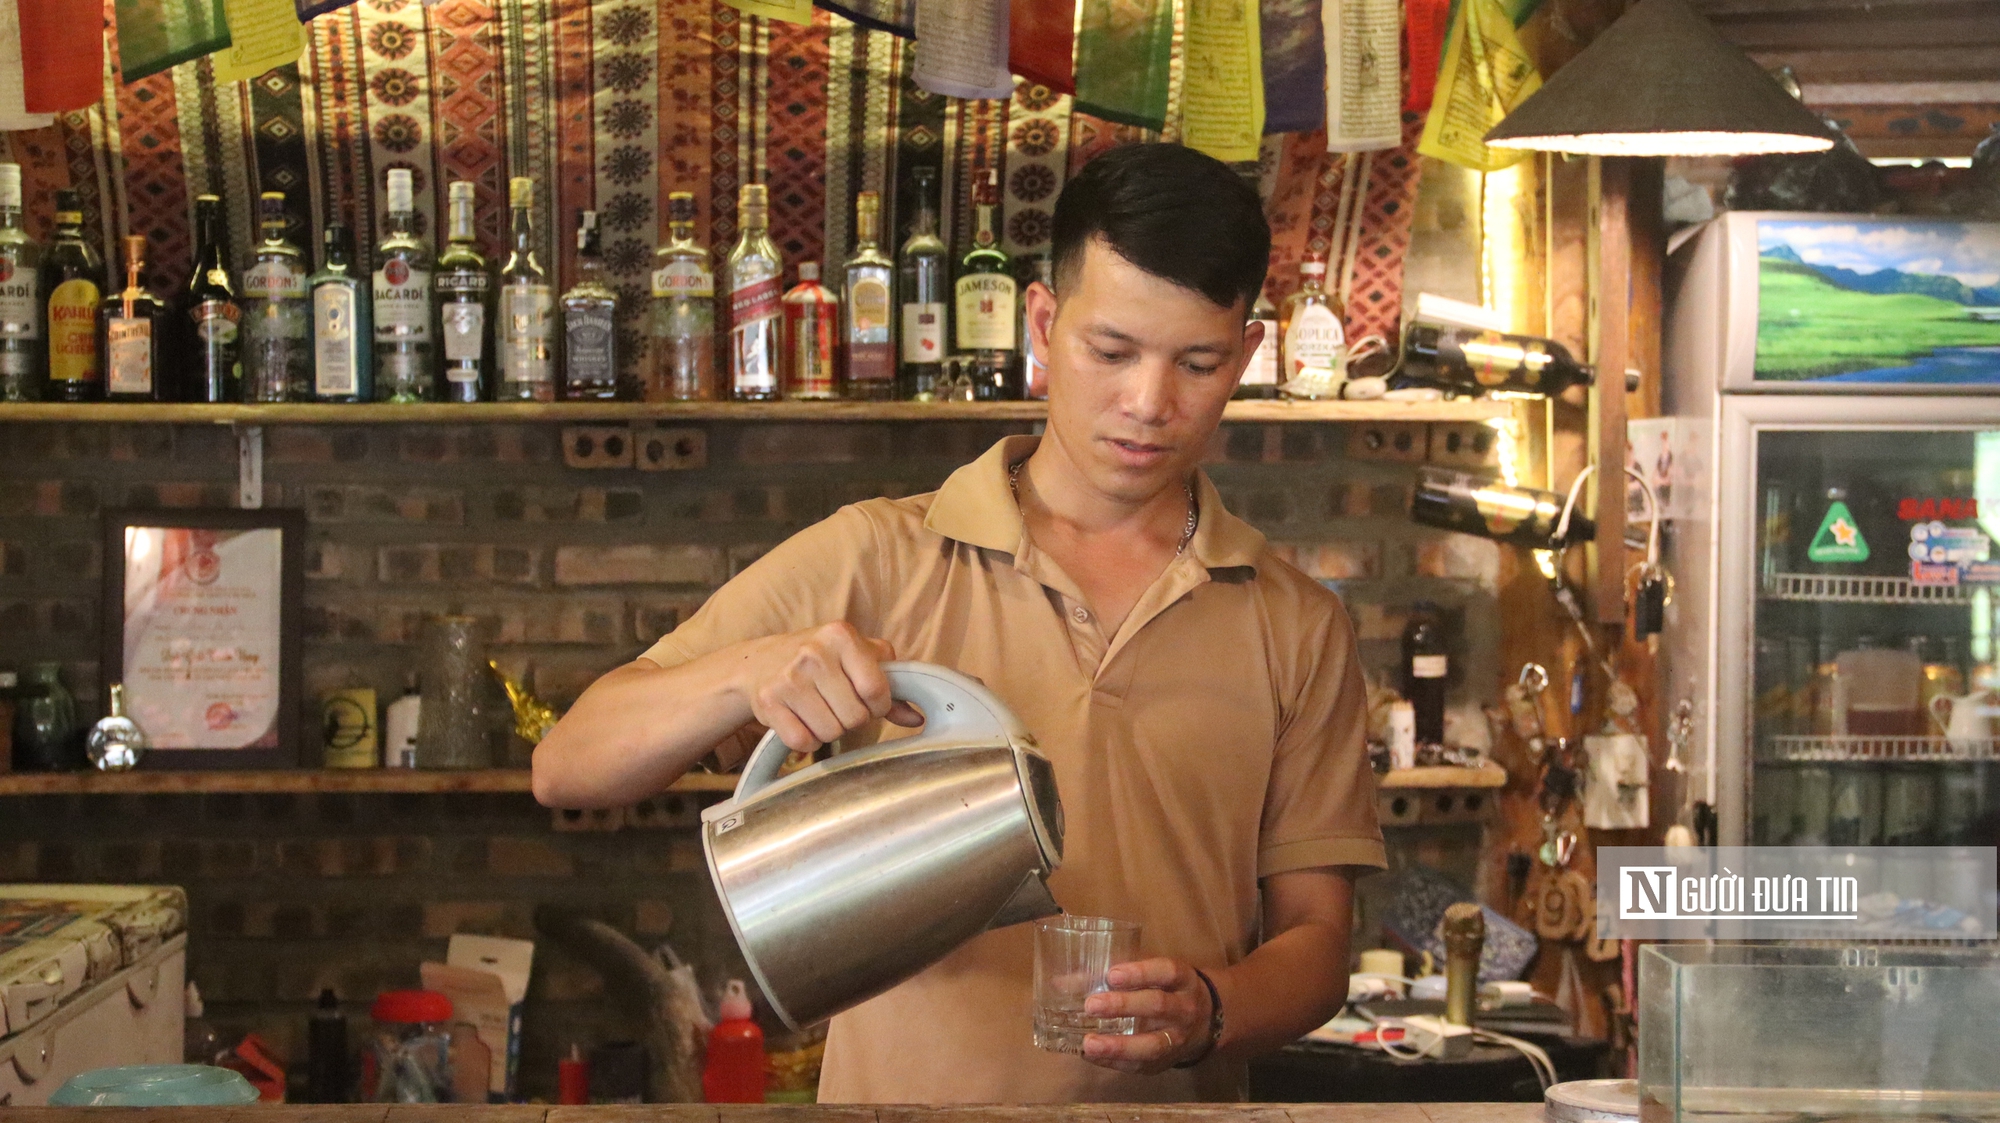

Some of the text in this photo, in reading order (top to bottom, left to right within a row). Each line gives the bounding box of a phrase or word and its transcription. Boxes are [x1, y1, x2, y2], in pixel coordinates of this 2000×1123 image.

[437, 276, 487, 288] RICARD
[958, 278, 1012, 297] JAMESON
[374, 287, 423, 301] BACARDÍ
